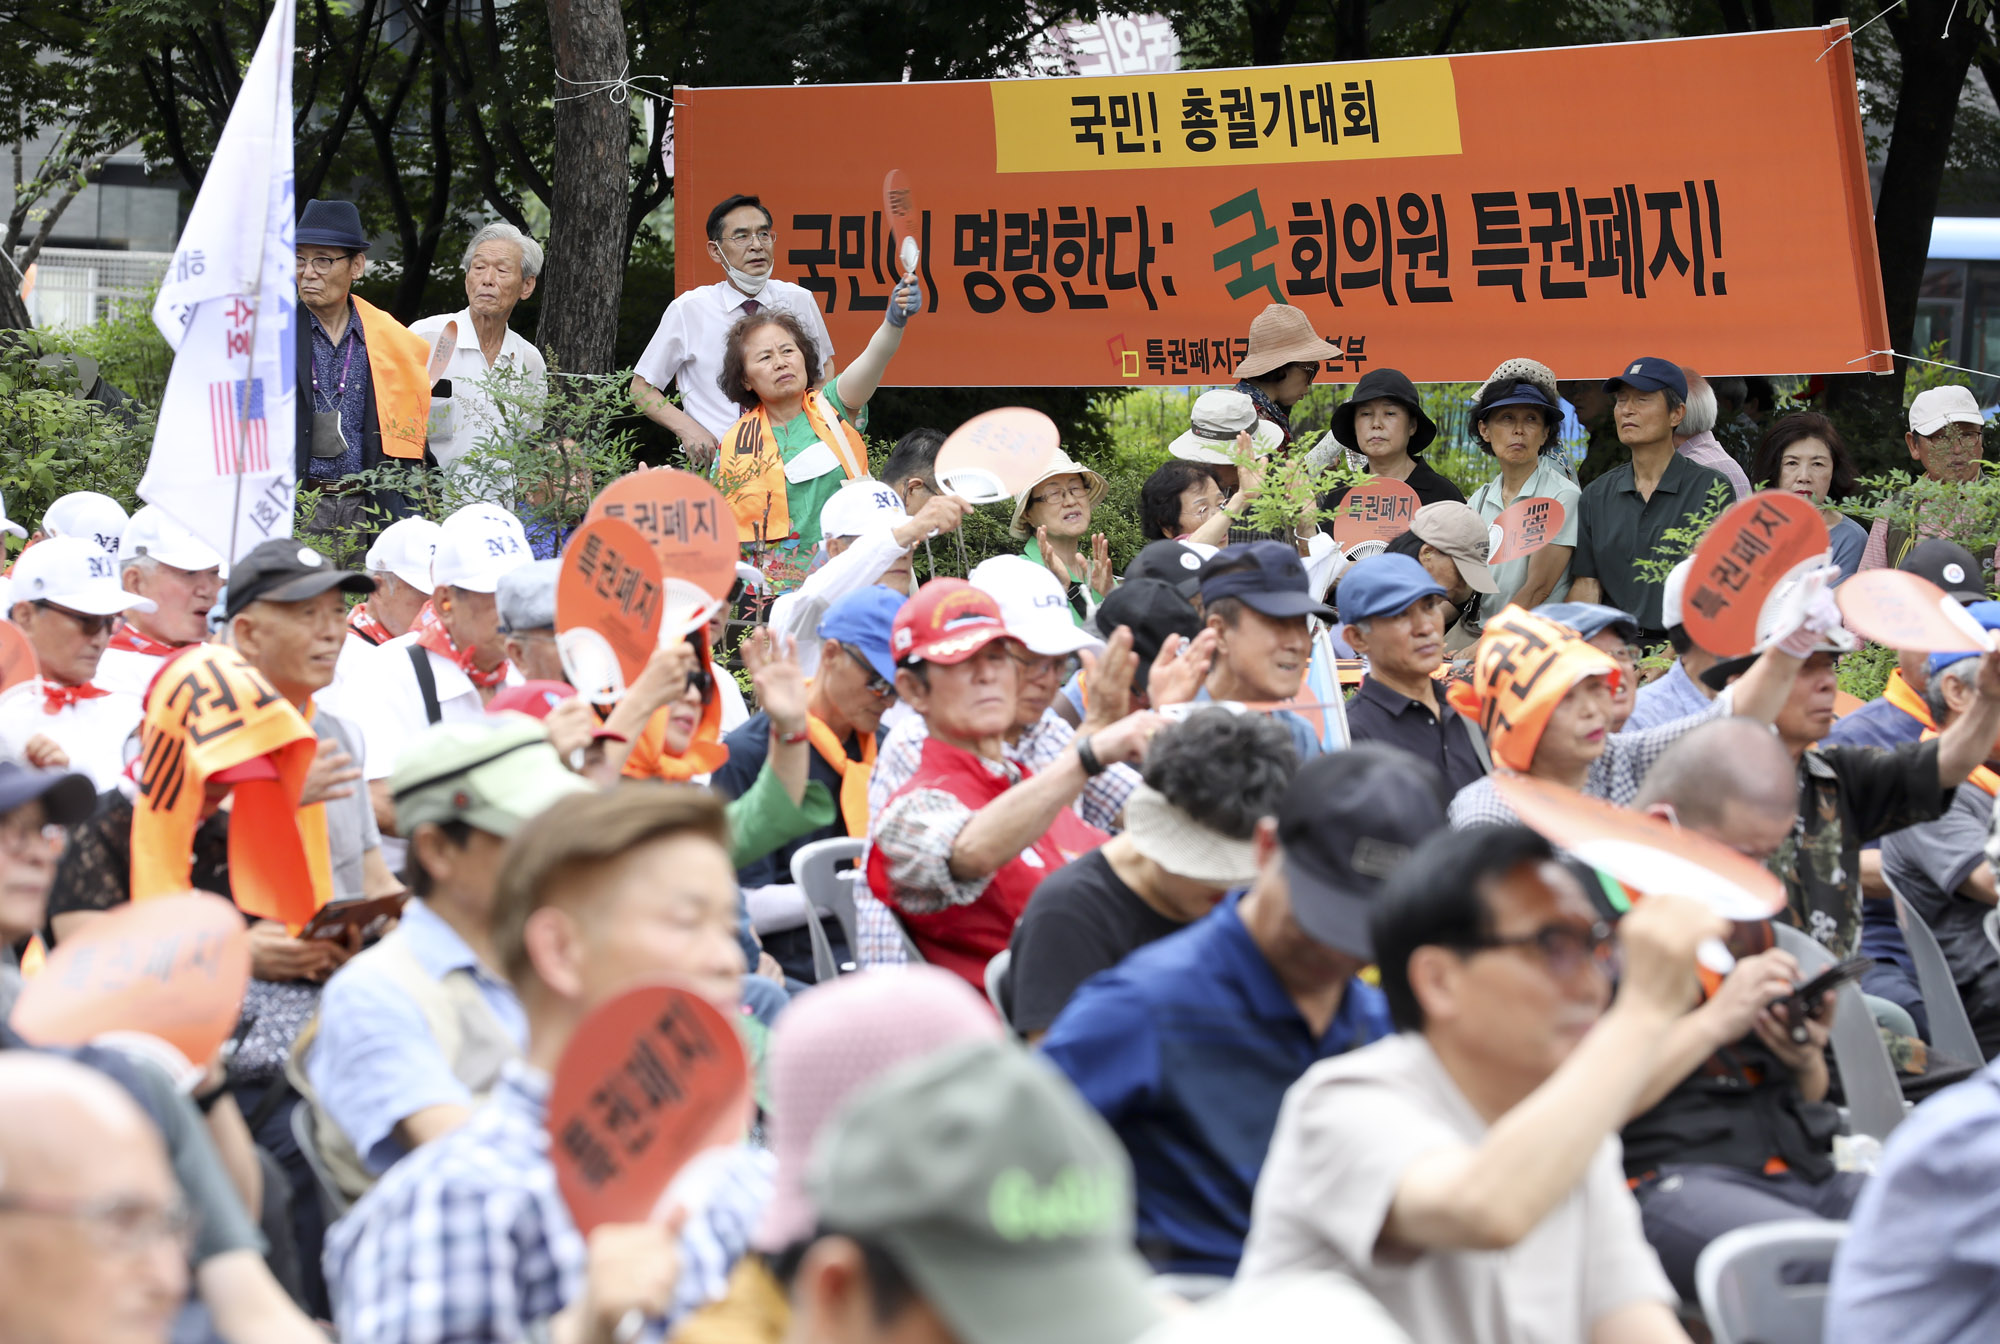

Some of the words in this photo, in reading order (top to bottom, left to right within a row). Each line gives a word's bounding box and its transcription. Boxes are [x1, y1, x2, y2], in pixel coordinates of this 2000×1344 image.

[1071, 92, 1162, 155] 국민!
[1182, 80, 1380, 152] 총궐기대회
[788, 211, 939, 313] 국민이
[953, 206, 1177, 313] 명령한다:
[1211, 189, 1453, 306] 국회의원
[1472, 180, 1727, 302] 특권폐지!
[1348, 495, 1414, 522] 특권폐지
[1519, 502, 1550, 551] 특권폐지
[576, 530, 662, 633] 특권폐지
[1690, 499, 1793, 621] 특권폐지
